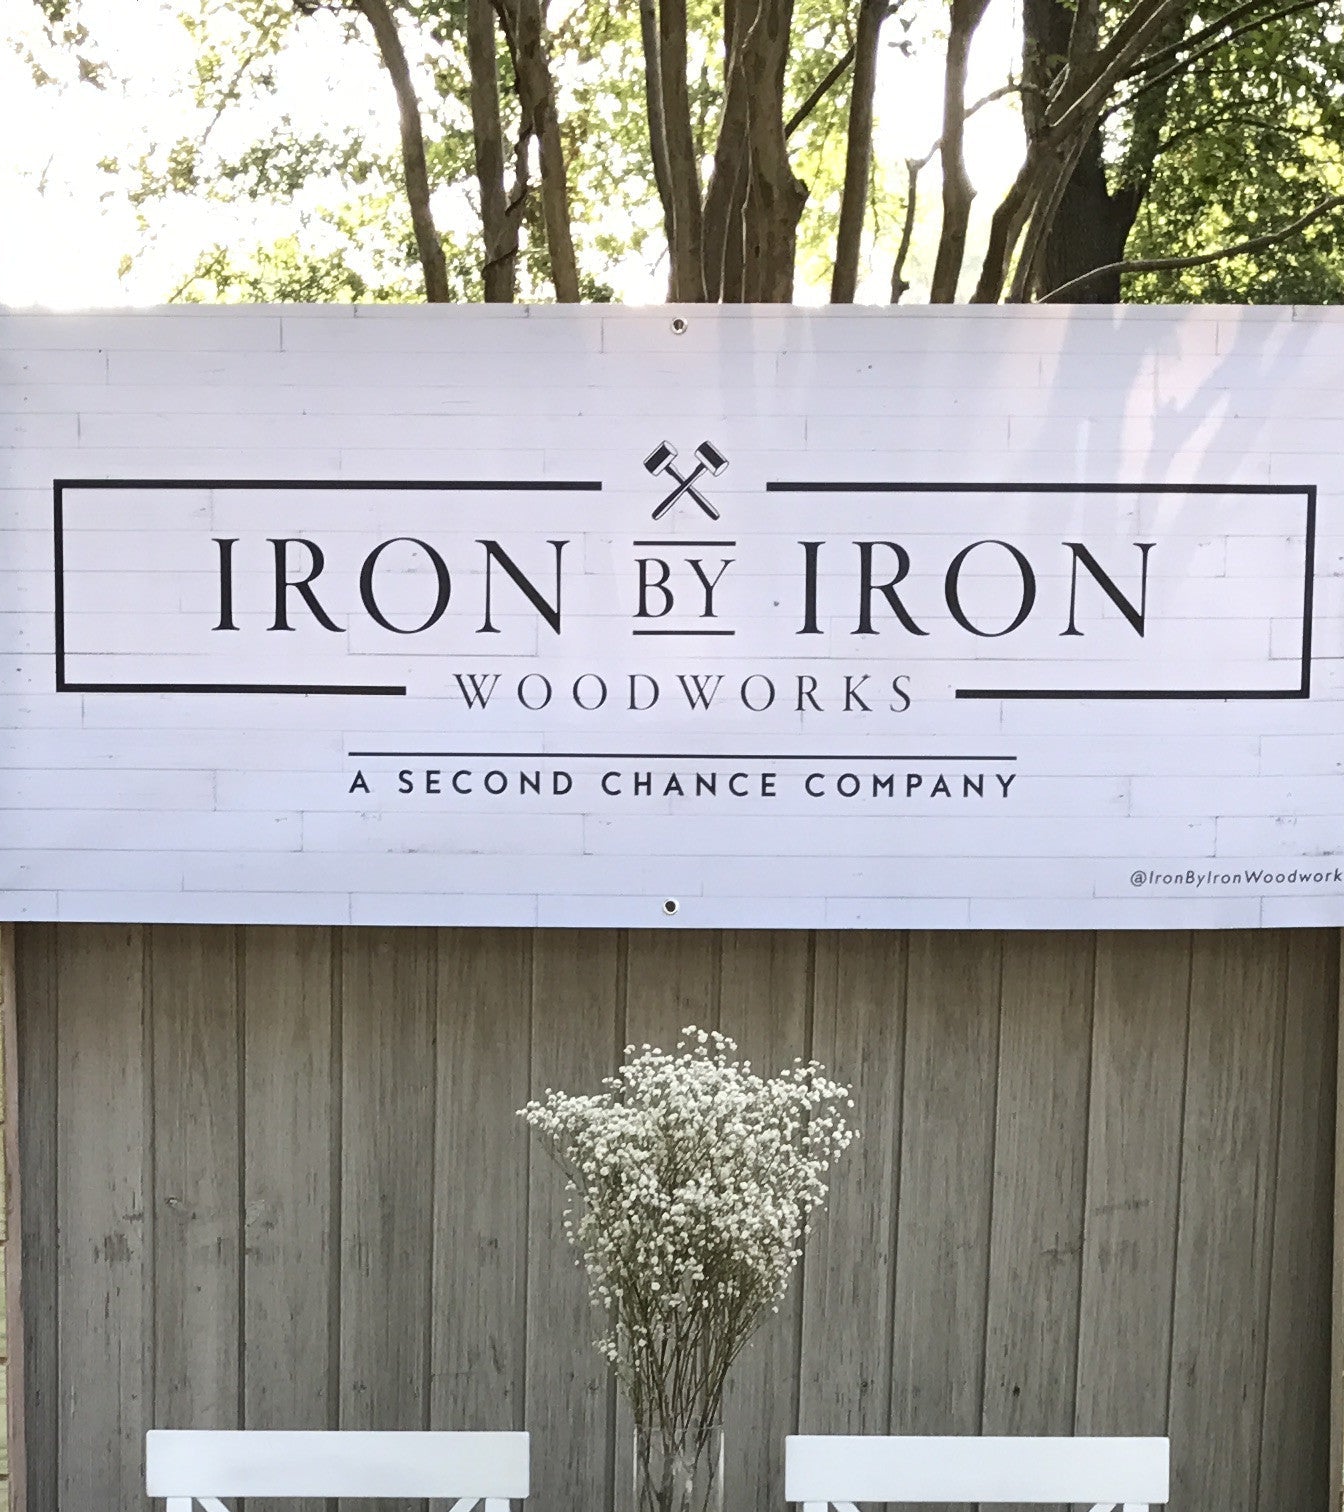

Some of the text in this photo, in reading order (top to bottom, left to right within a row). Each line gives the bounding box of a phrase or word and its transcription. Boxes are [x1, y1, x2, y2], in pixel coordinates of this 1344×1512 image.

[211, 537, 1157, 638] IRON BY IRON
[454, 673, 912, 713] WOODWORKS
[348, 769, 1017, 798] A SECOND CHANCE COMPANY
